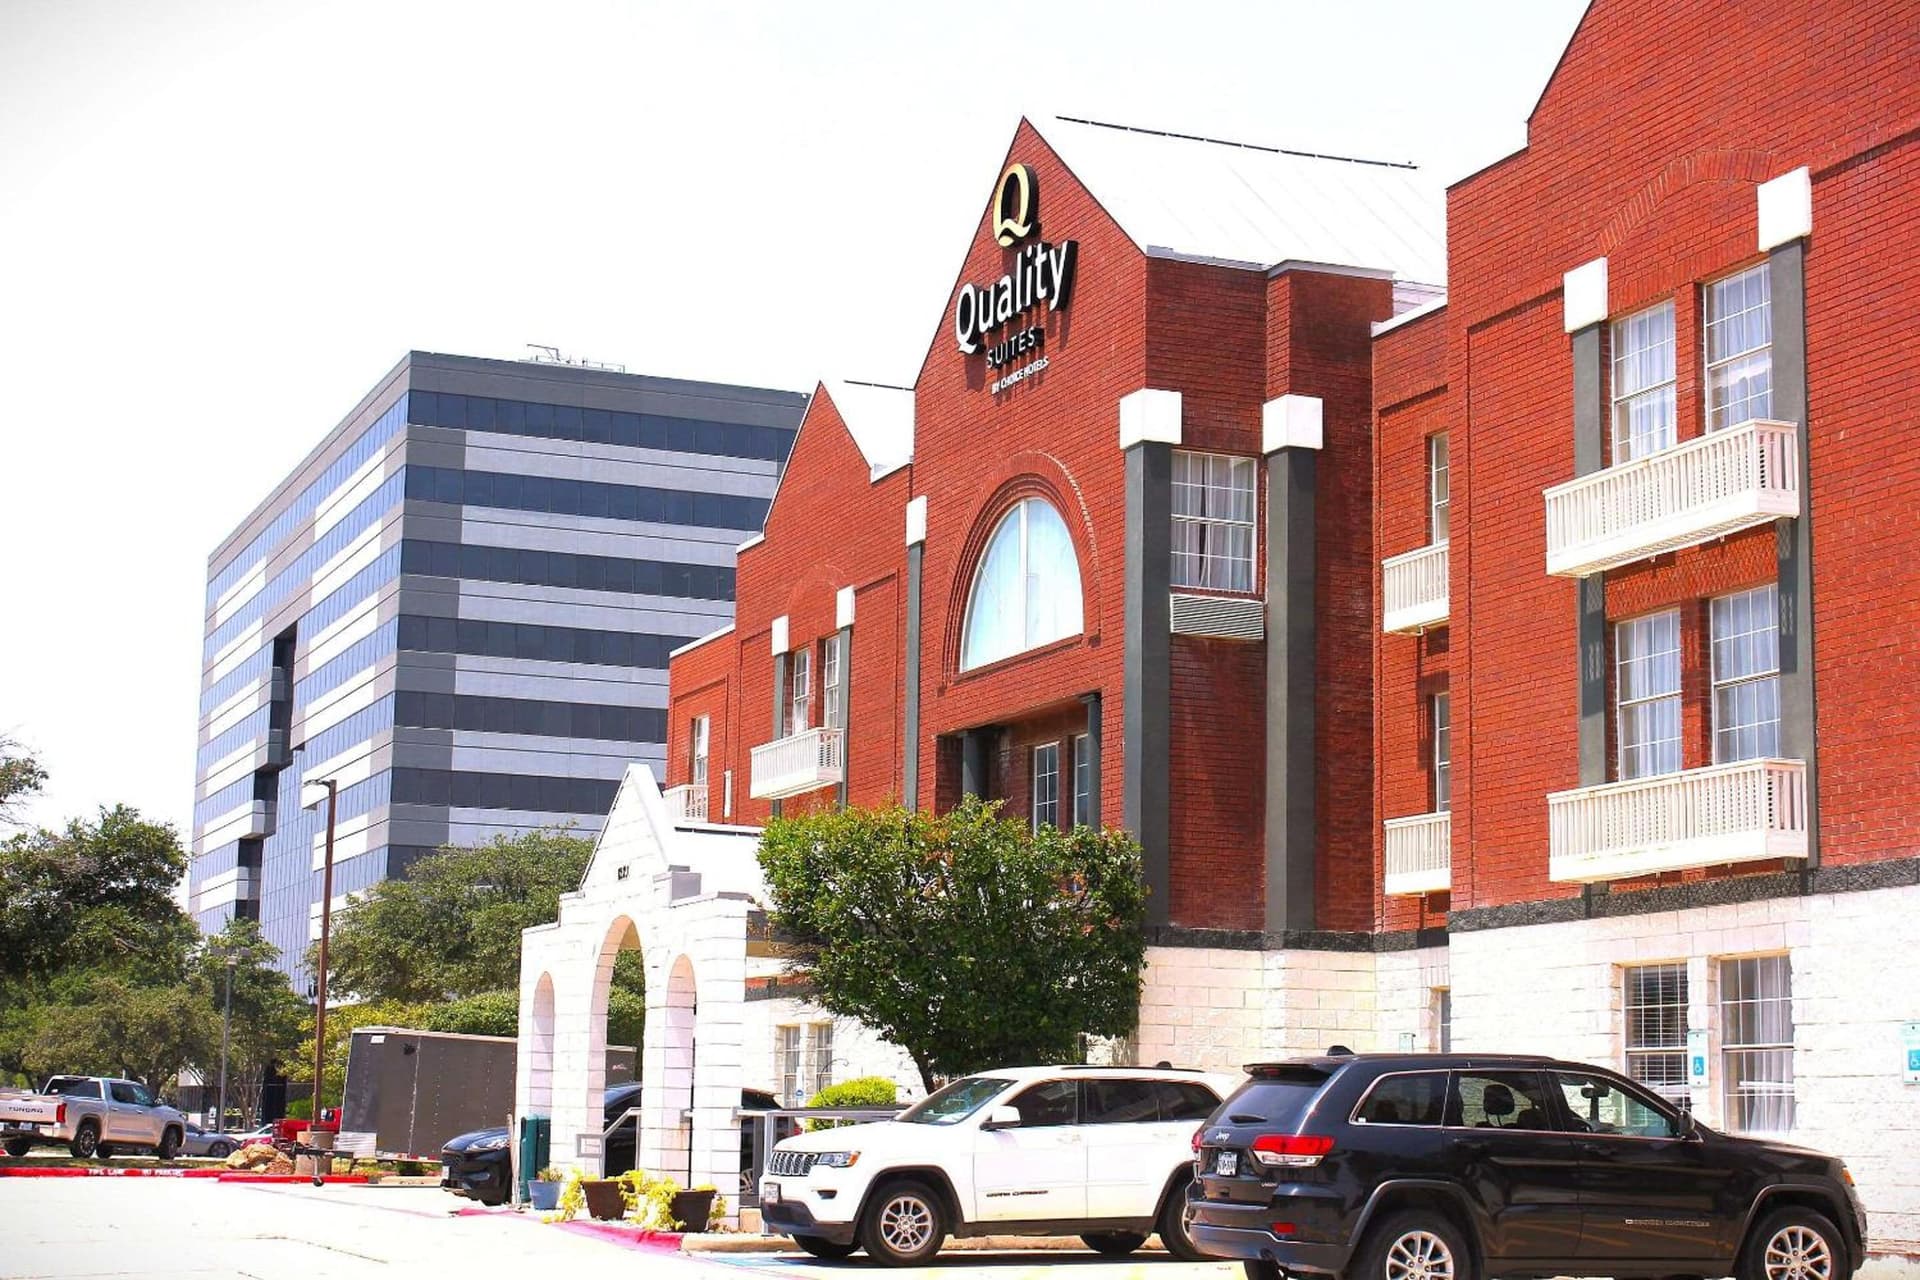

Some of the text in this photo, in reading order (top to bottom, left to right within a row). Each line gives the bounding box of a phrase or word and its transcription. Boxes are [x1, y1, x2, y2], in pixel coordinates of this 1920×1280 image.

[993, 163, 1032, 247] Q
[955, 240, 1068, 354] Quality
[986, 326, 1035, 369] SUITES
[991, 355, 1050, 395] BY CHOICE HOTELS
